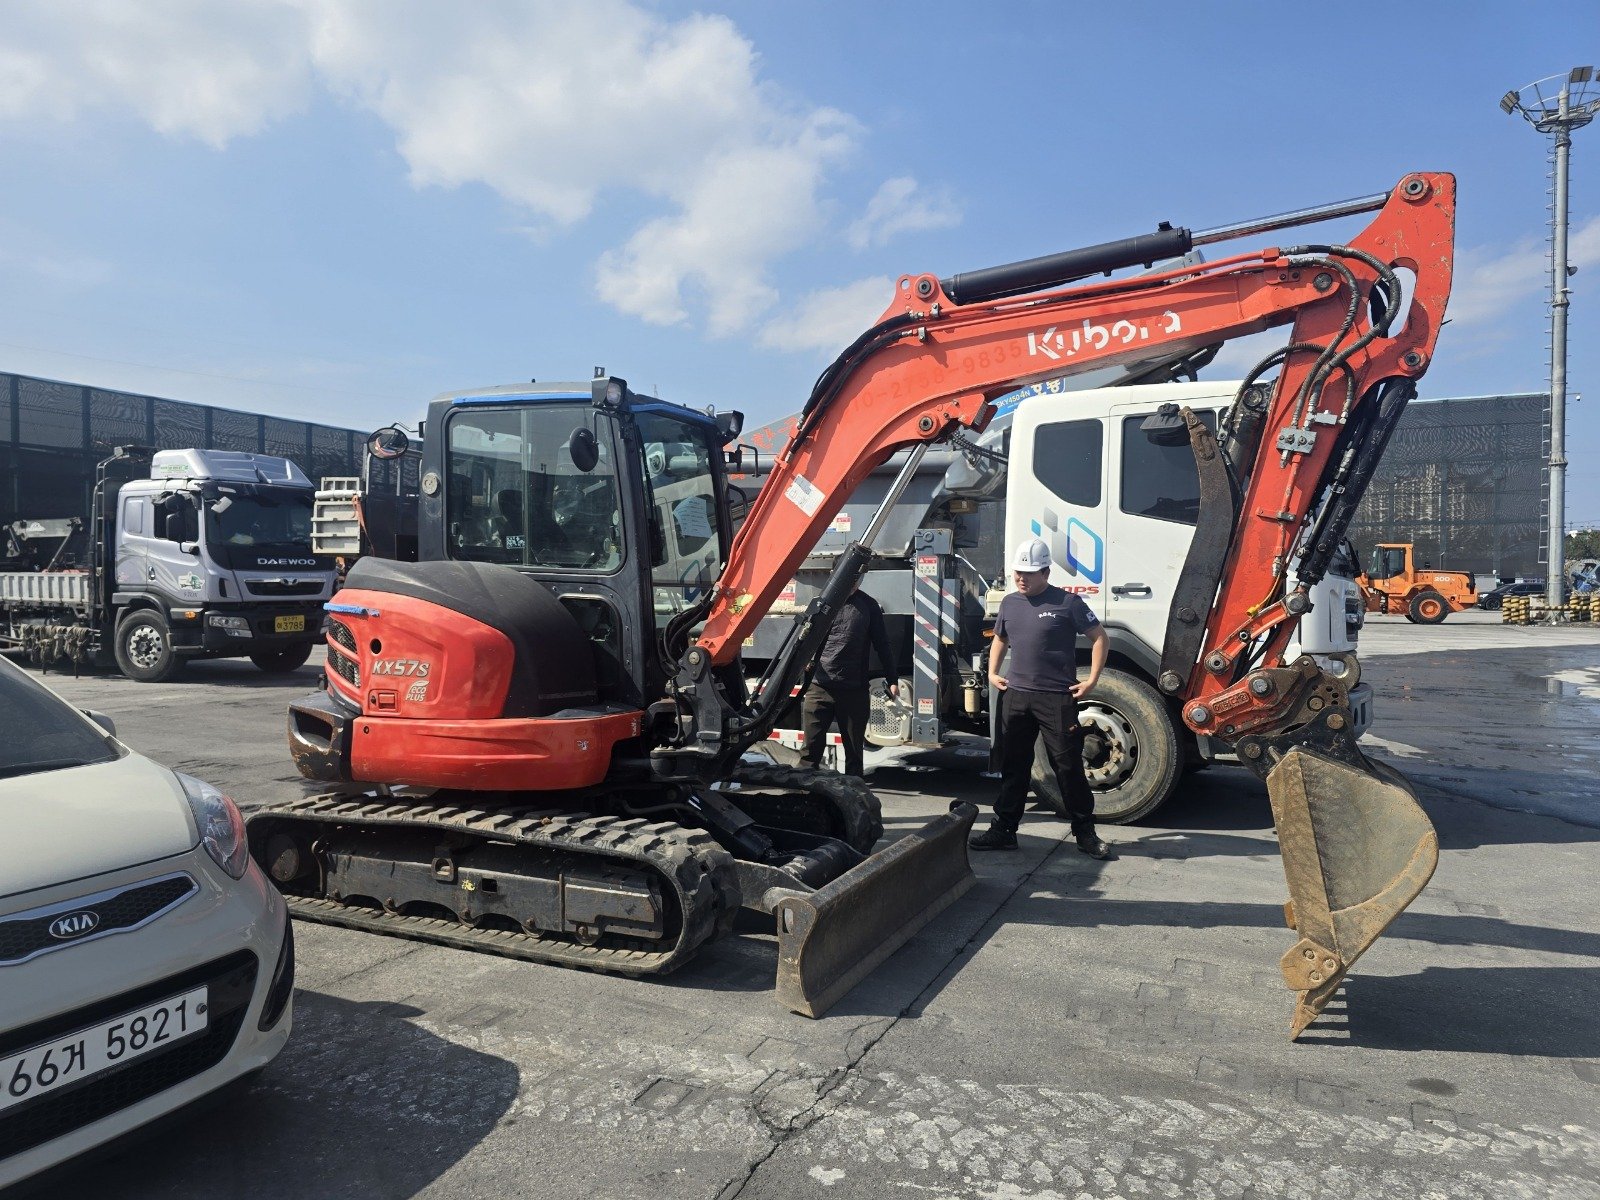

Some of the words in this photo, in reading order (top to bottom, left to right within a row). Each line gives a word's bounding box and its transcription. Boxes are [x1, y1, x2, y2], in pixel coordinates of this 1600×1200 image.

[257, 558, 316, 566] DAEWOO
[372, 659, 431, 678] KX57S
[405, 693, 426, 702] PLUS
[58, 914, 94, 935] KIA
[8, 1039, 86, 1098] 66거
[106, 999, 187, 1061] 5821
